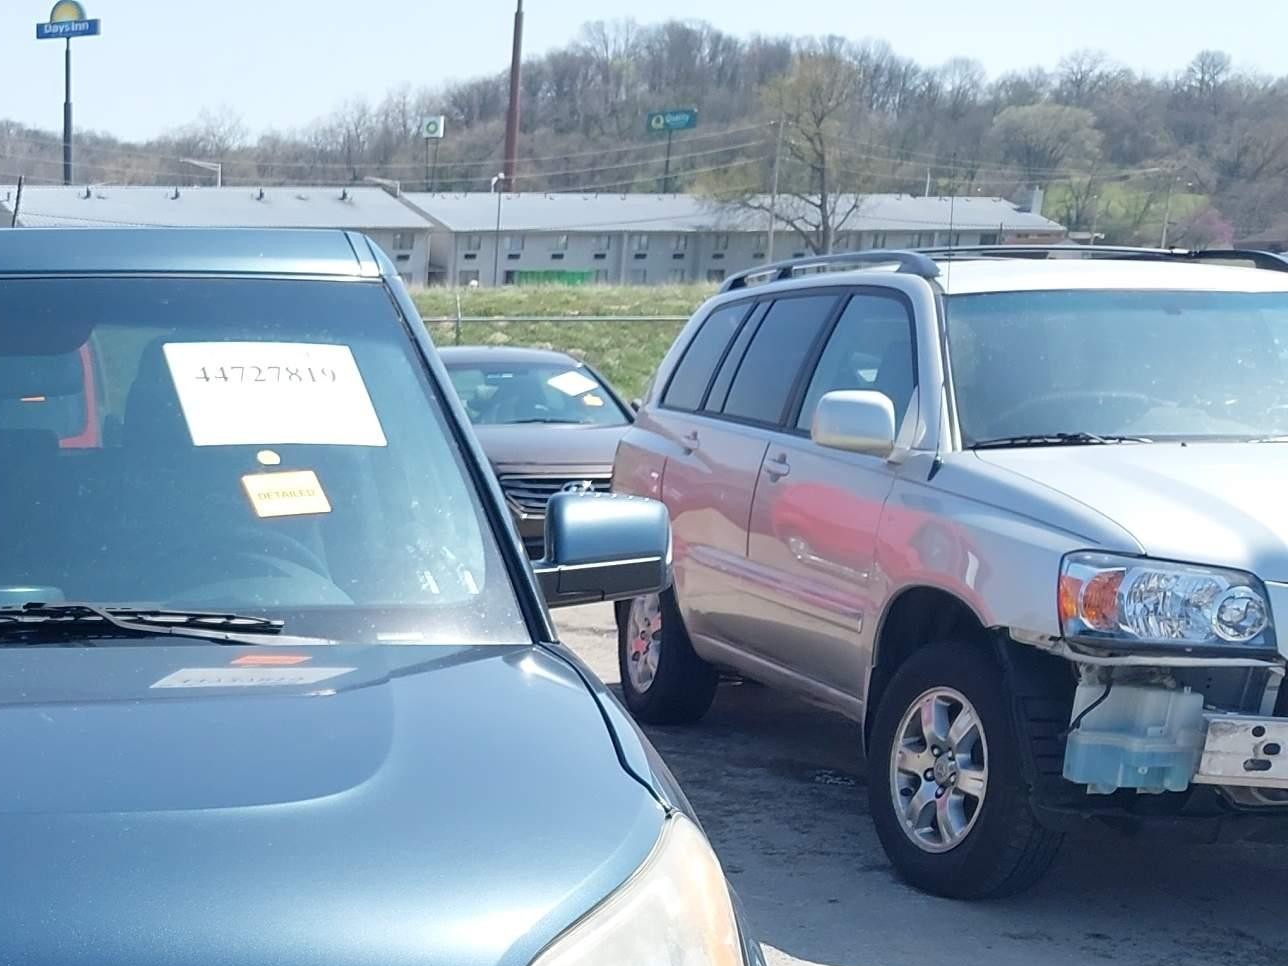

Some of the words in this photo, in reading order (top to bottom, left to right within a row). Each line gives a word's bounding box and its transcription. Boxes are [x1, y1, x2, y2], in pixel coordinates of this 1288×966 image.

[43, 23, 69, 34] Days
[71, 21, 89, 32] Inn
[195, 366, 337, 383] 44727819
